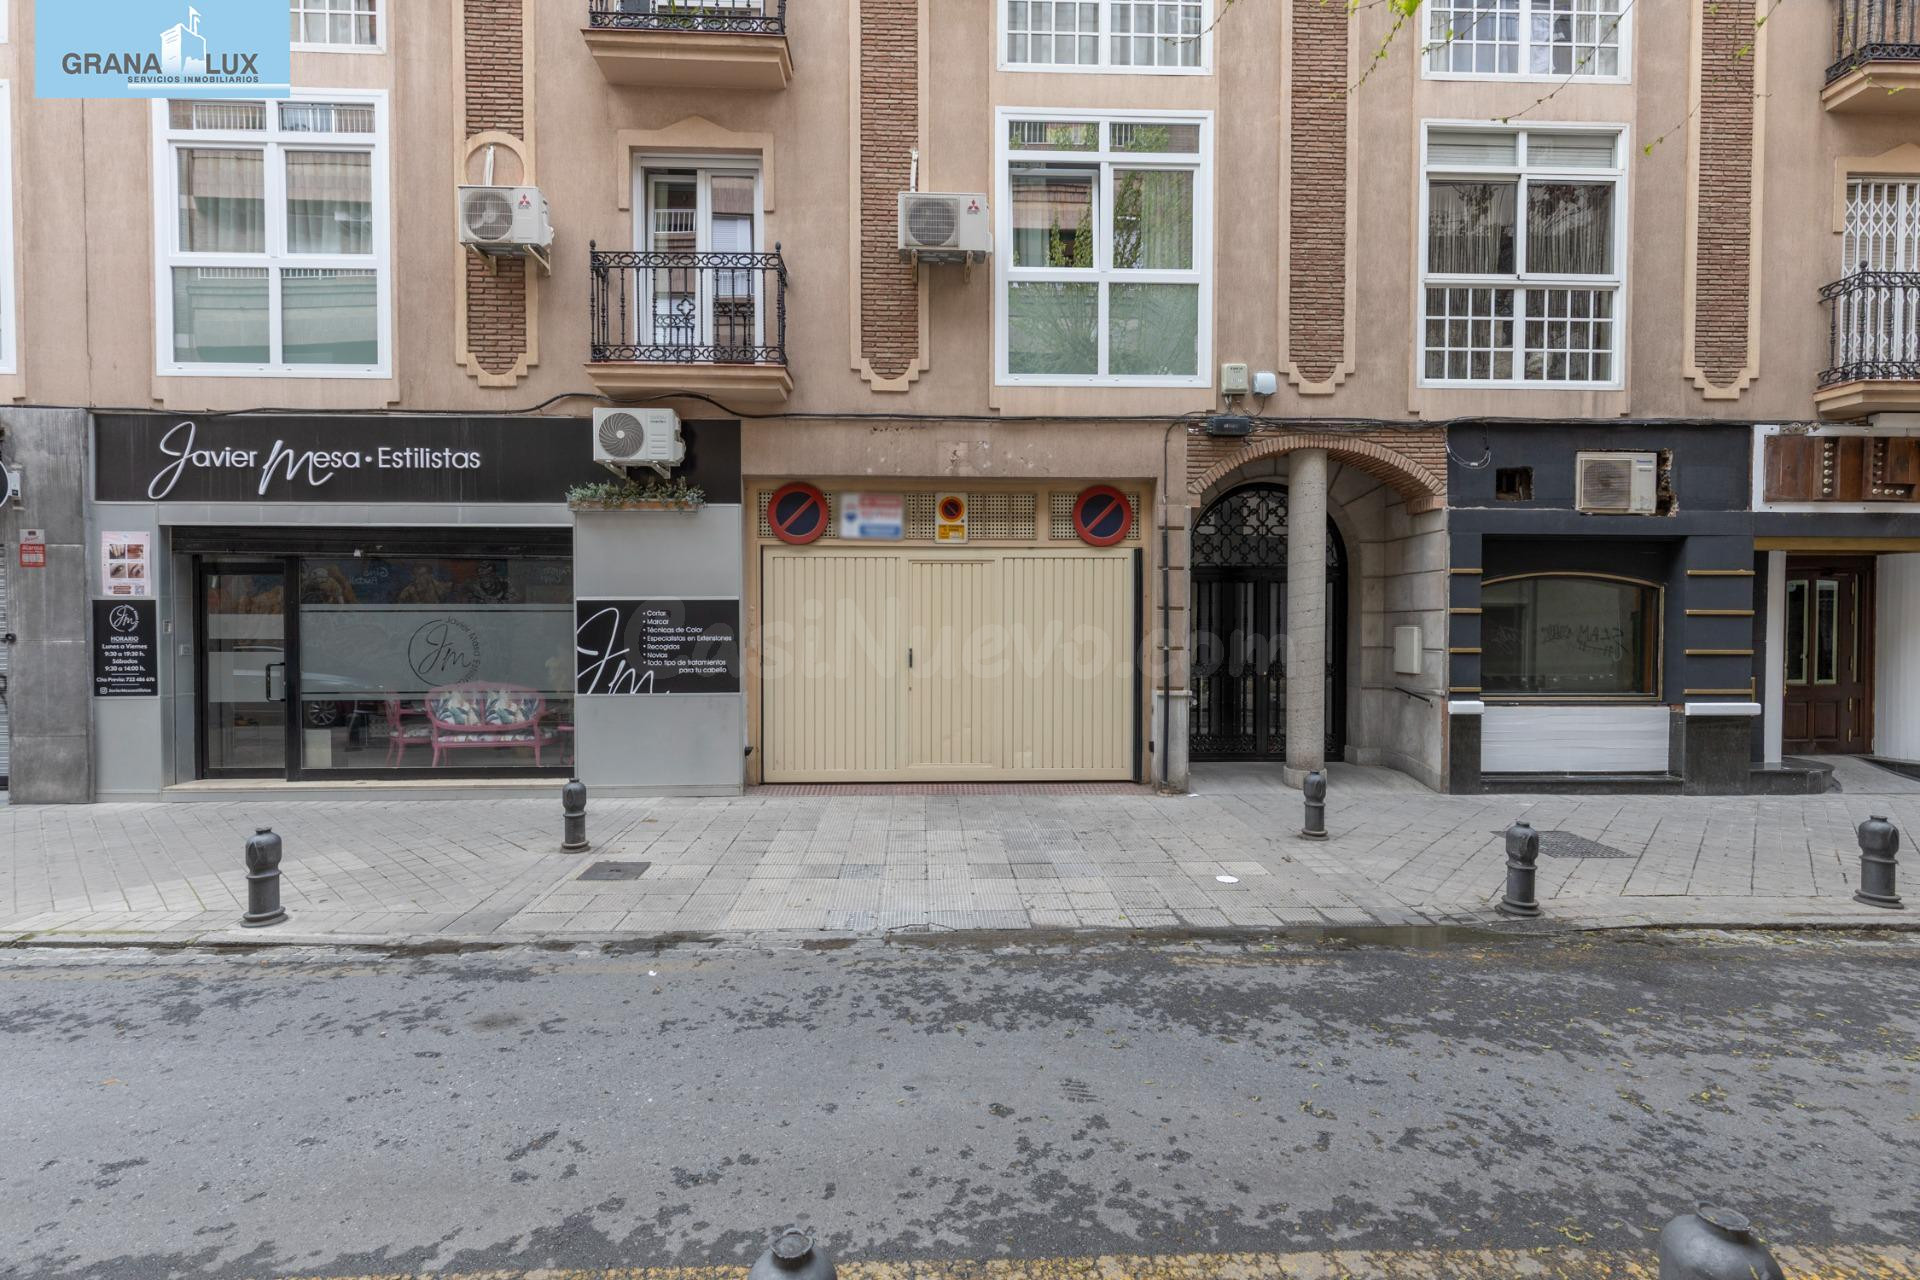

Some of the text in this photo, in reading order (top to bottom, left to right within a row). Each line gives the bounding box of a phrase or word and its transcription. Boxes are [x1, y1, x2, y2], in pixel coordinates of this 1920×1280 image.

[148, 421, 481, 499] Javier Mesa Estilistas
[664, 659, 676, 667] tipo
